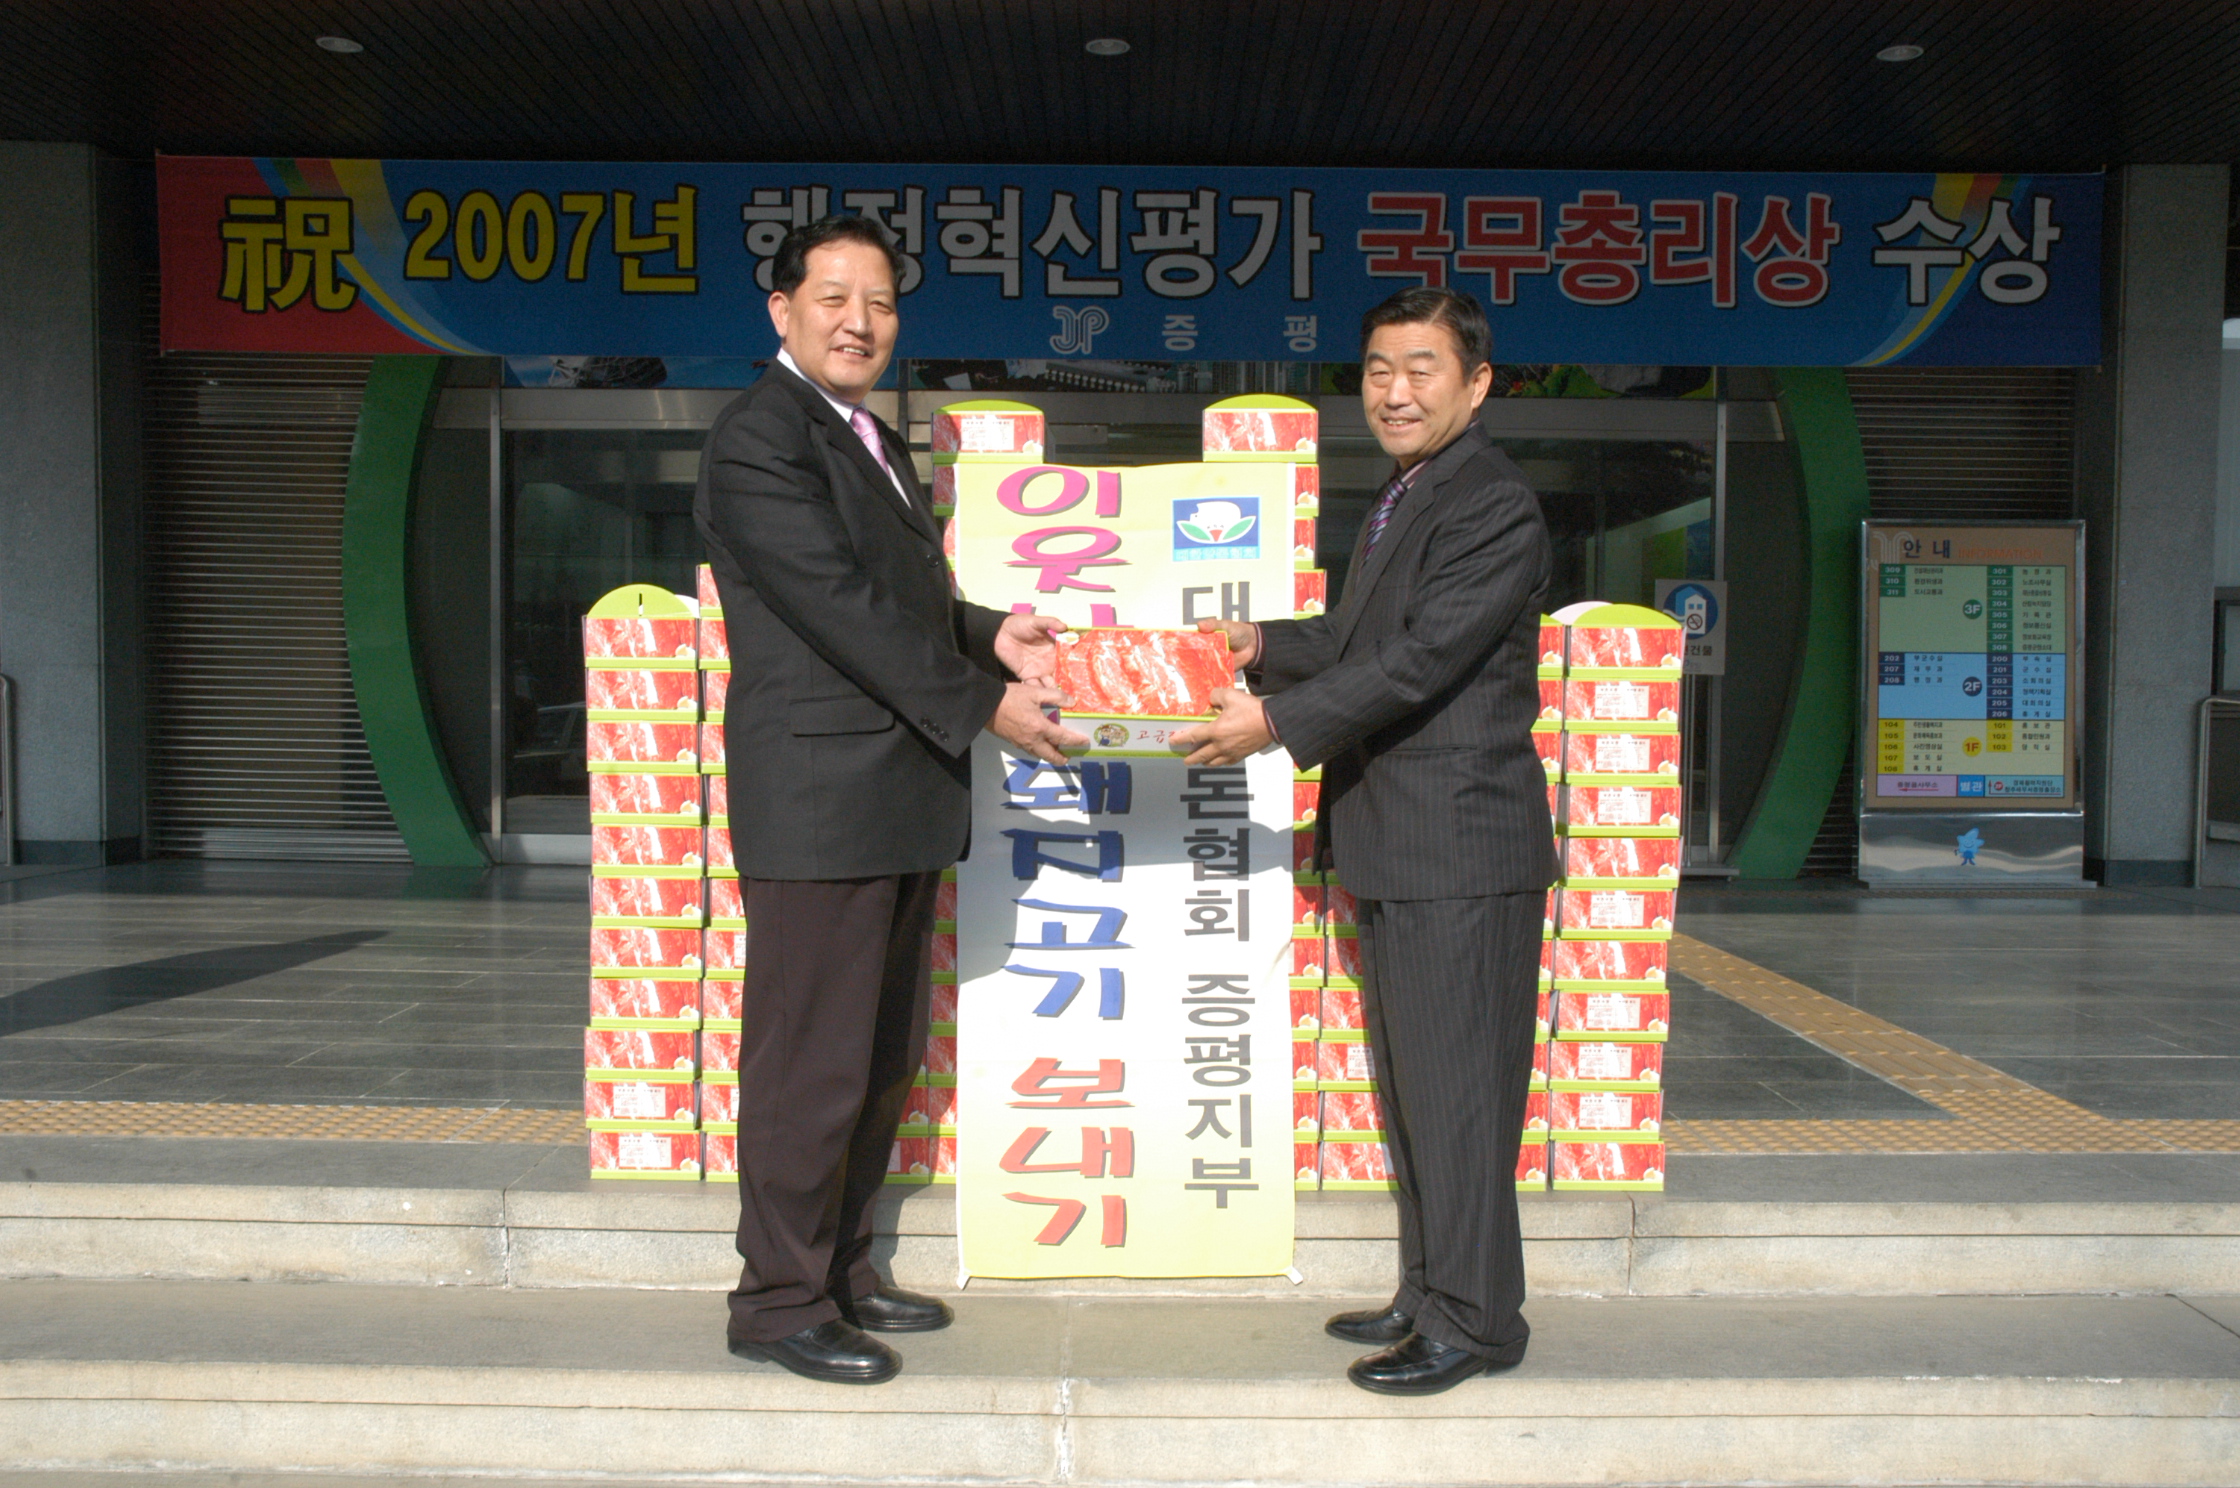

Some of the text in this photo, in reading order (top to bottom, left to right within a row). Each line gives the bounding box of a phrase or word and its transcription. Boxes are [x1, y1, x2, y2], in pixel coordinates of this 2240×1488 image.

[219, 195, 360, 314] 祝
[402, 183, 700, 296] 2007년
[1356, 189, 1842, 310] 국무총리상
[1872, 194, 2063, 306] 수상
[1958, 547, 2043, 559] INFORMATION
[1886, 588, 1899, 596] 311
[1964, 603, 1981, 615] 3F
[1991, 611, 2008, 619] 305
[1991, 655, 2008, 663] 200
[1991, 677, 2008, 685] 203
[1964, 681, 1981, 692] 2F
[1991, 688, 2008, 696] 204
[1991, 699, 2008, 707] 205
[1991, 710, 2008, 718] 206
[1965, 742, 1980, 752] 1F
[1960, 781, 1983, 792] 별관
[1181, 973, 1260, 1209] 증평지부
[998, 1057, 1136, 1248] 보내기
